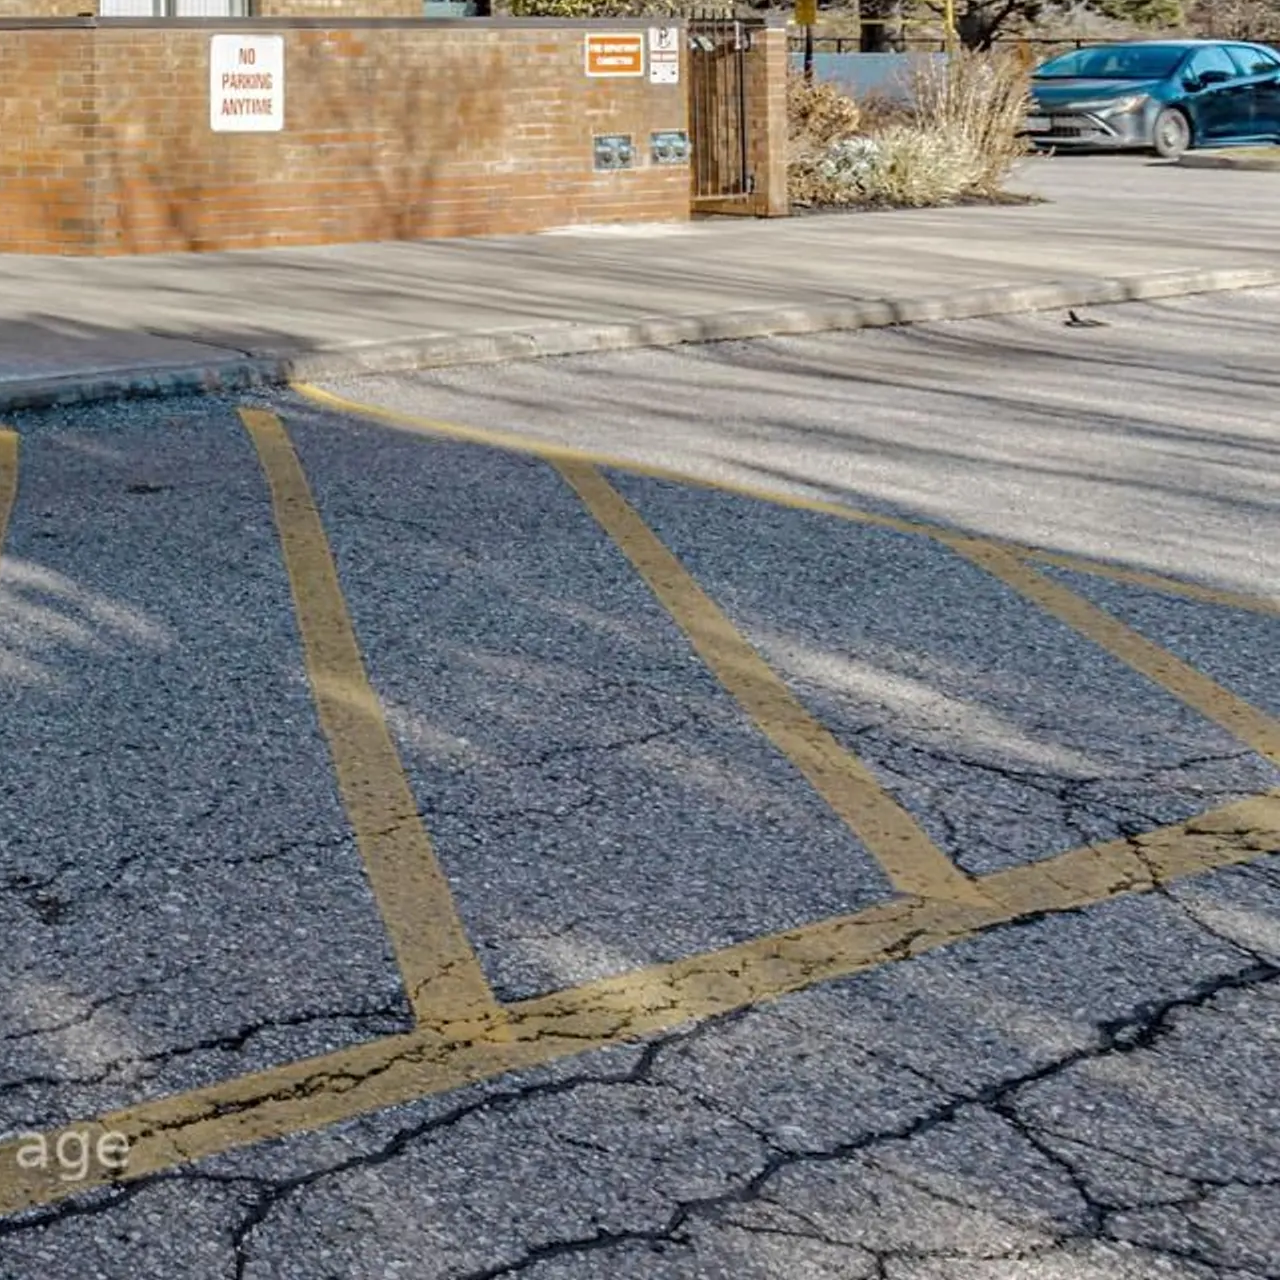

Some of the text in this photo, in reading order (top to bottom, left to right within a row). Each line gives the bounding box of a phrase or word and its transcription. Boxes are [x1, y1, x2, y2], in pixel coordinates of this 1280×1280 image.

[239, 48, 256, 65] NO
[222, 72, 273, 90] PARKING
[221, 99, 273, 116] ANYTIME
